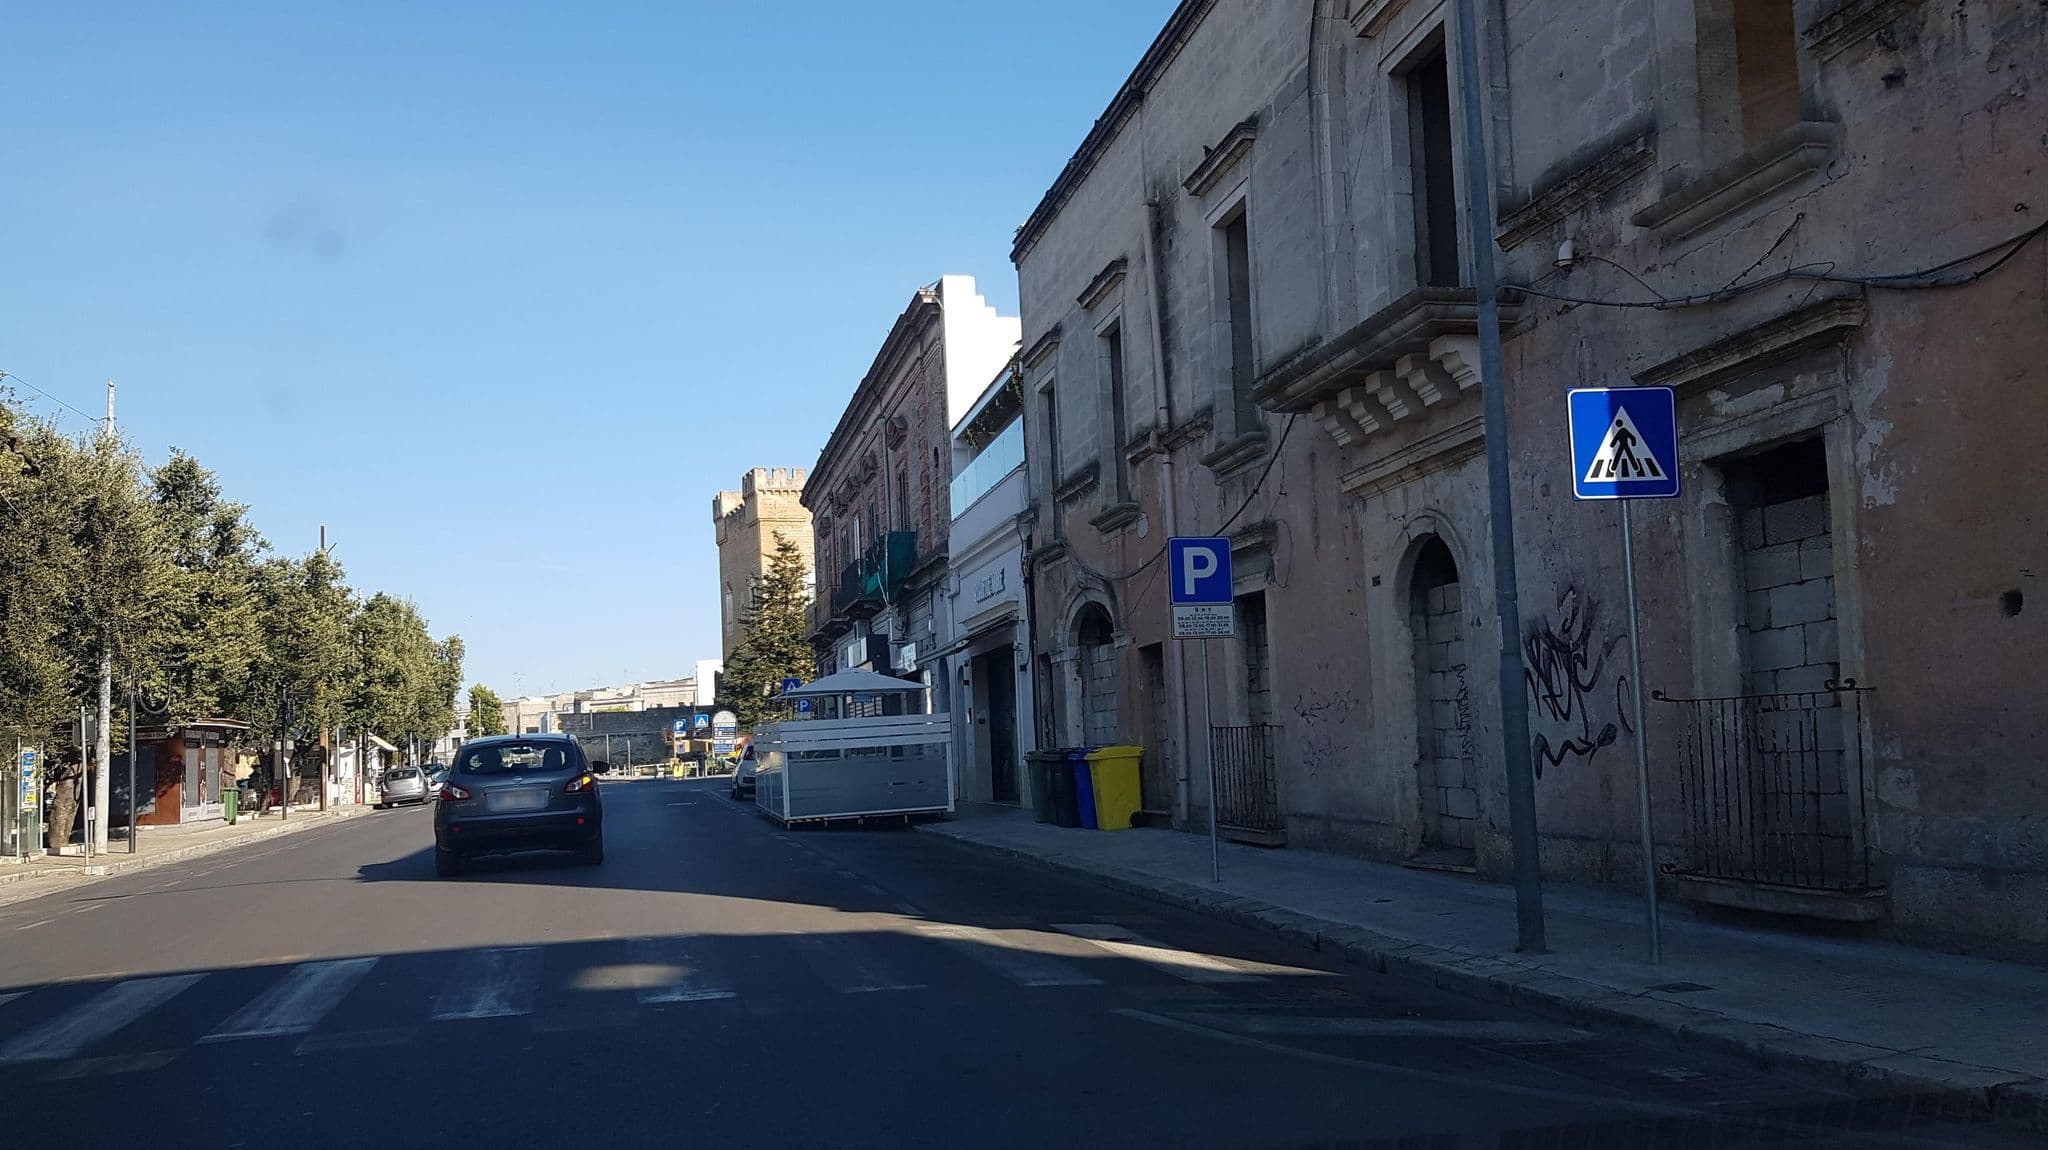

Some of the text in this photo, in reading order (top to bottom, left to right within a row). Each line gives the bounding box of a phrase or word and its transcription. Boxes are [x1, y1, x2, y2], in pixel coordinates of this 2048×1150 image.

[1183, 546, 1218, 595] P
[800, 700, 809, 711] P
[675, 721, 684, 730] P
